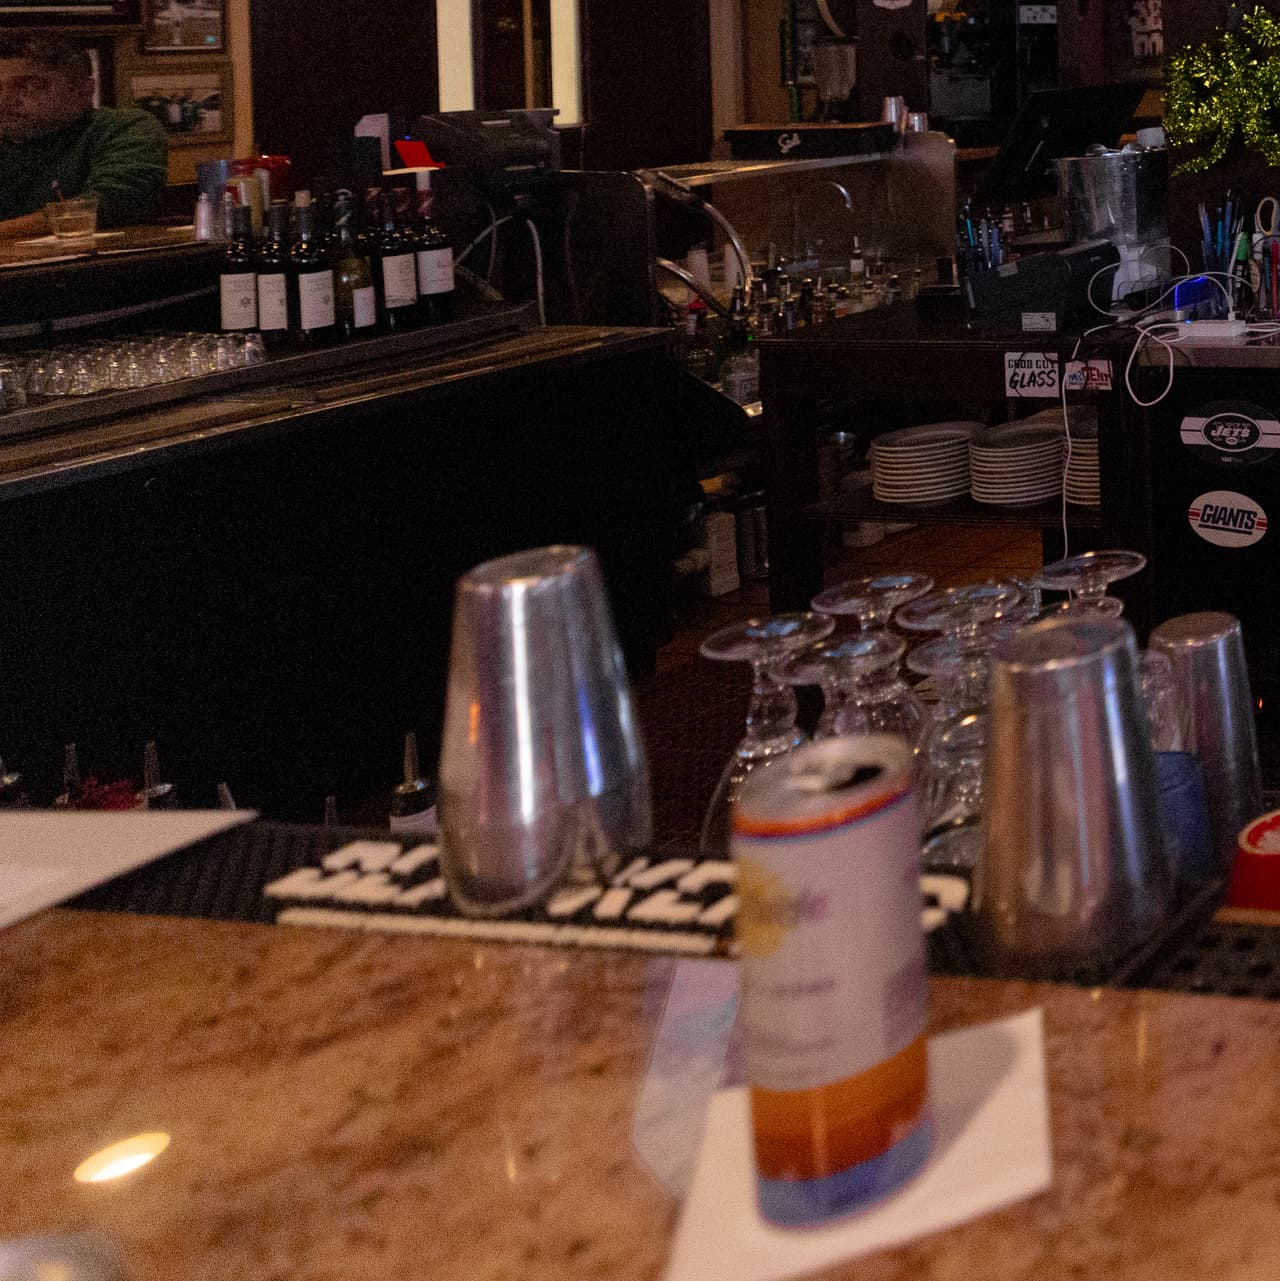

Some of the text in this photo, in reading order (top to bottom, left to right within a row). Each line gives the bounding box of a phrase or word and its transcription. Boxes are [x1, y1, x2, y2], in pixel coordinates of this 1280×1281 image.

[1009, 369, 1057, 389] GLASS
[1210, 427, 1251, 438] JETS
[1200, 504, 1258, 531] GIANTS
